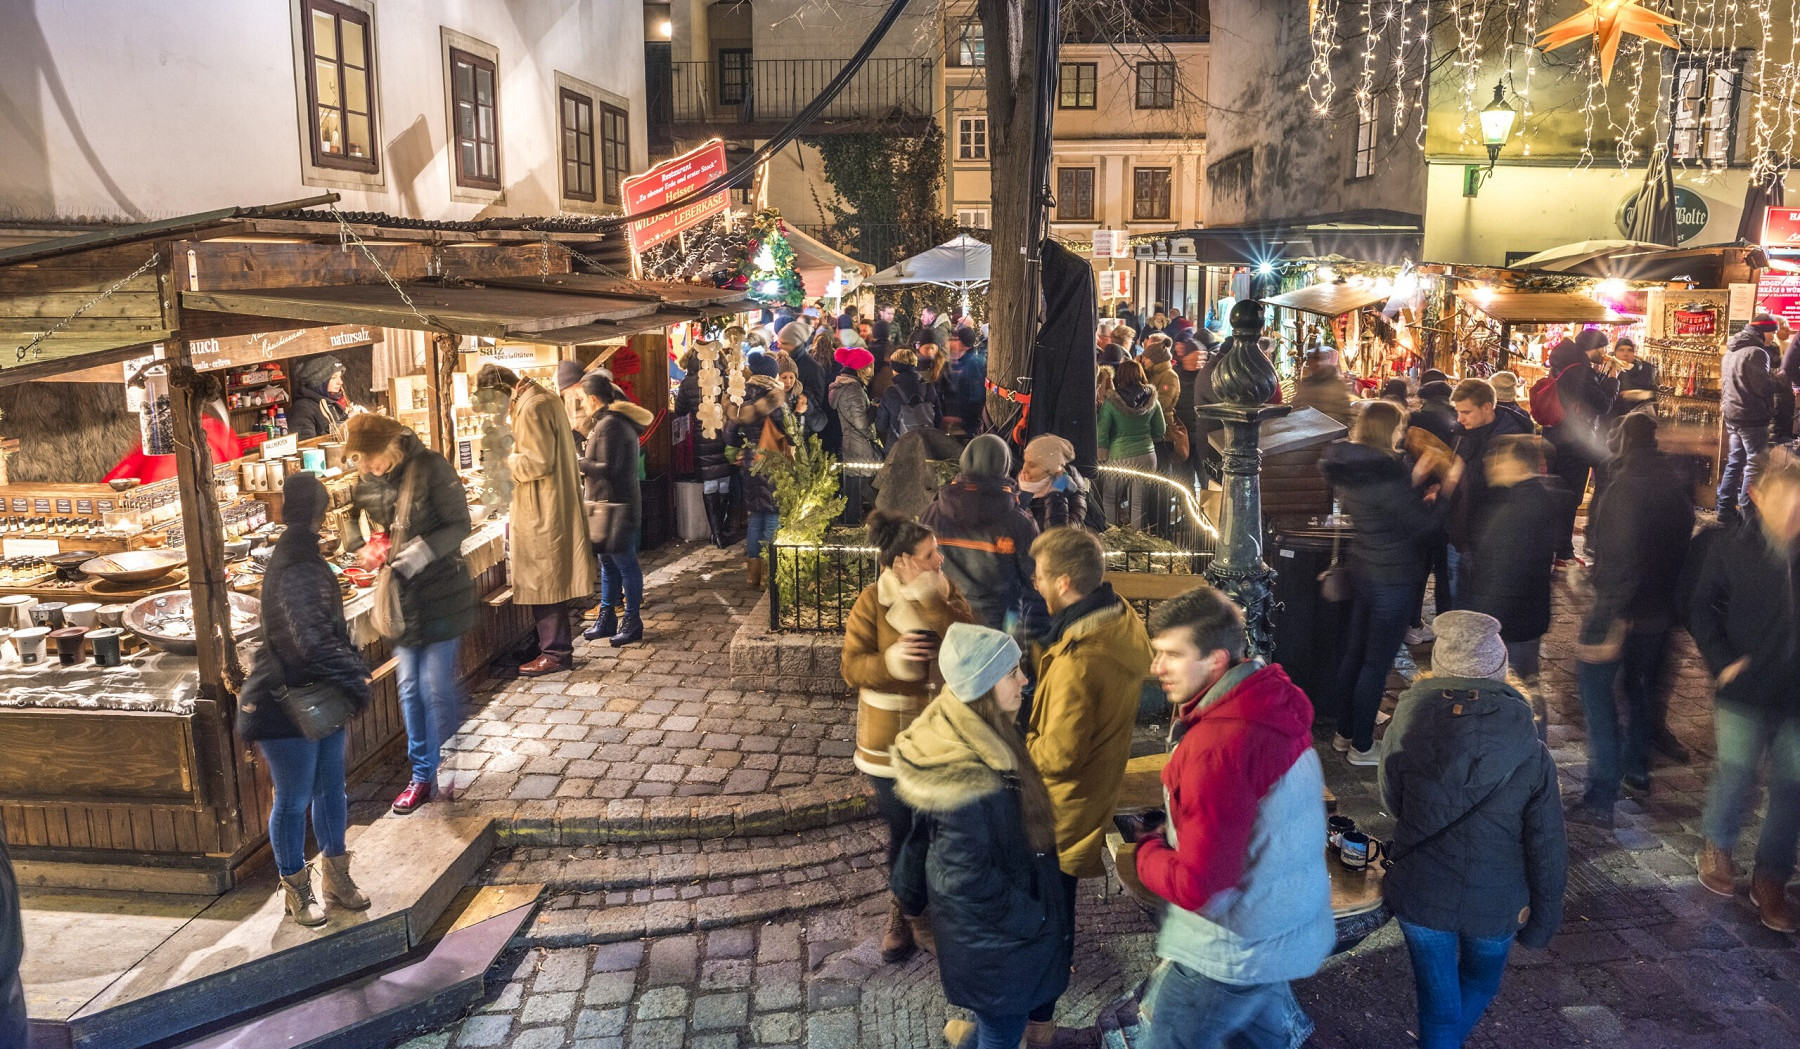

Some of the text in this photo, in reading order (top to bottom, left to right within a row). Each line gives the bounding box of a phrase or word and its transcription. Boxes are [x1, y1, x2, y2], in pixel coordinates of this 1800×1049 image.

[661, 162, 692, 182] Restaurant
[677, 175, 686, 184] und
[665, 183, 695, 203] Heisser
[1675, 206, 1707, 226] Bolte
[330, 327, 371, 347] natursalz
[480, 347, 505, 358] salz
[494, 352, 534, 361] spezialitäten
